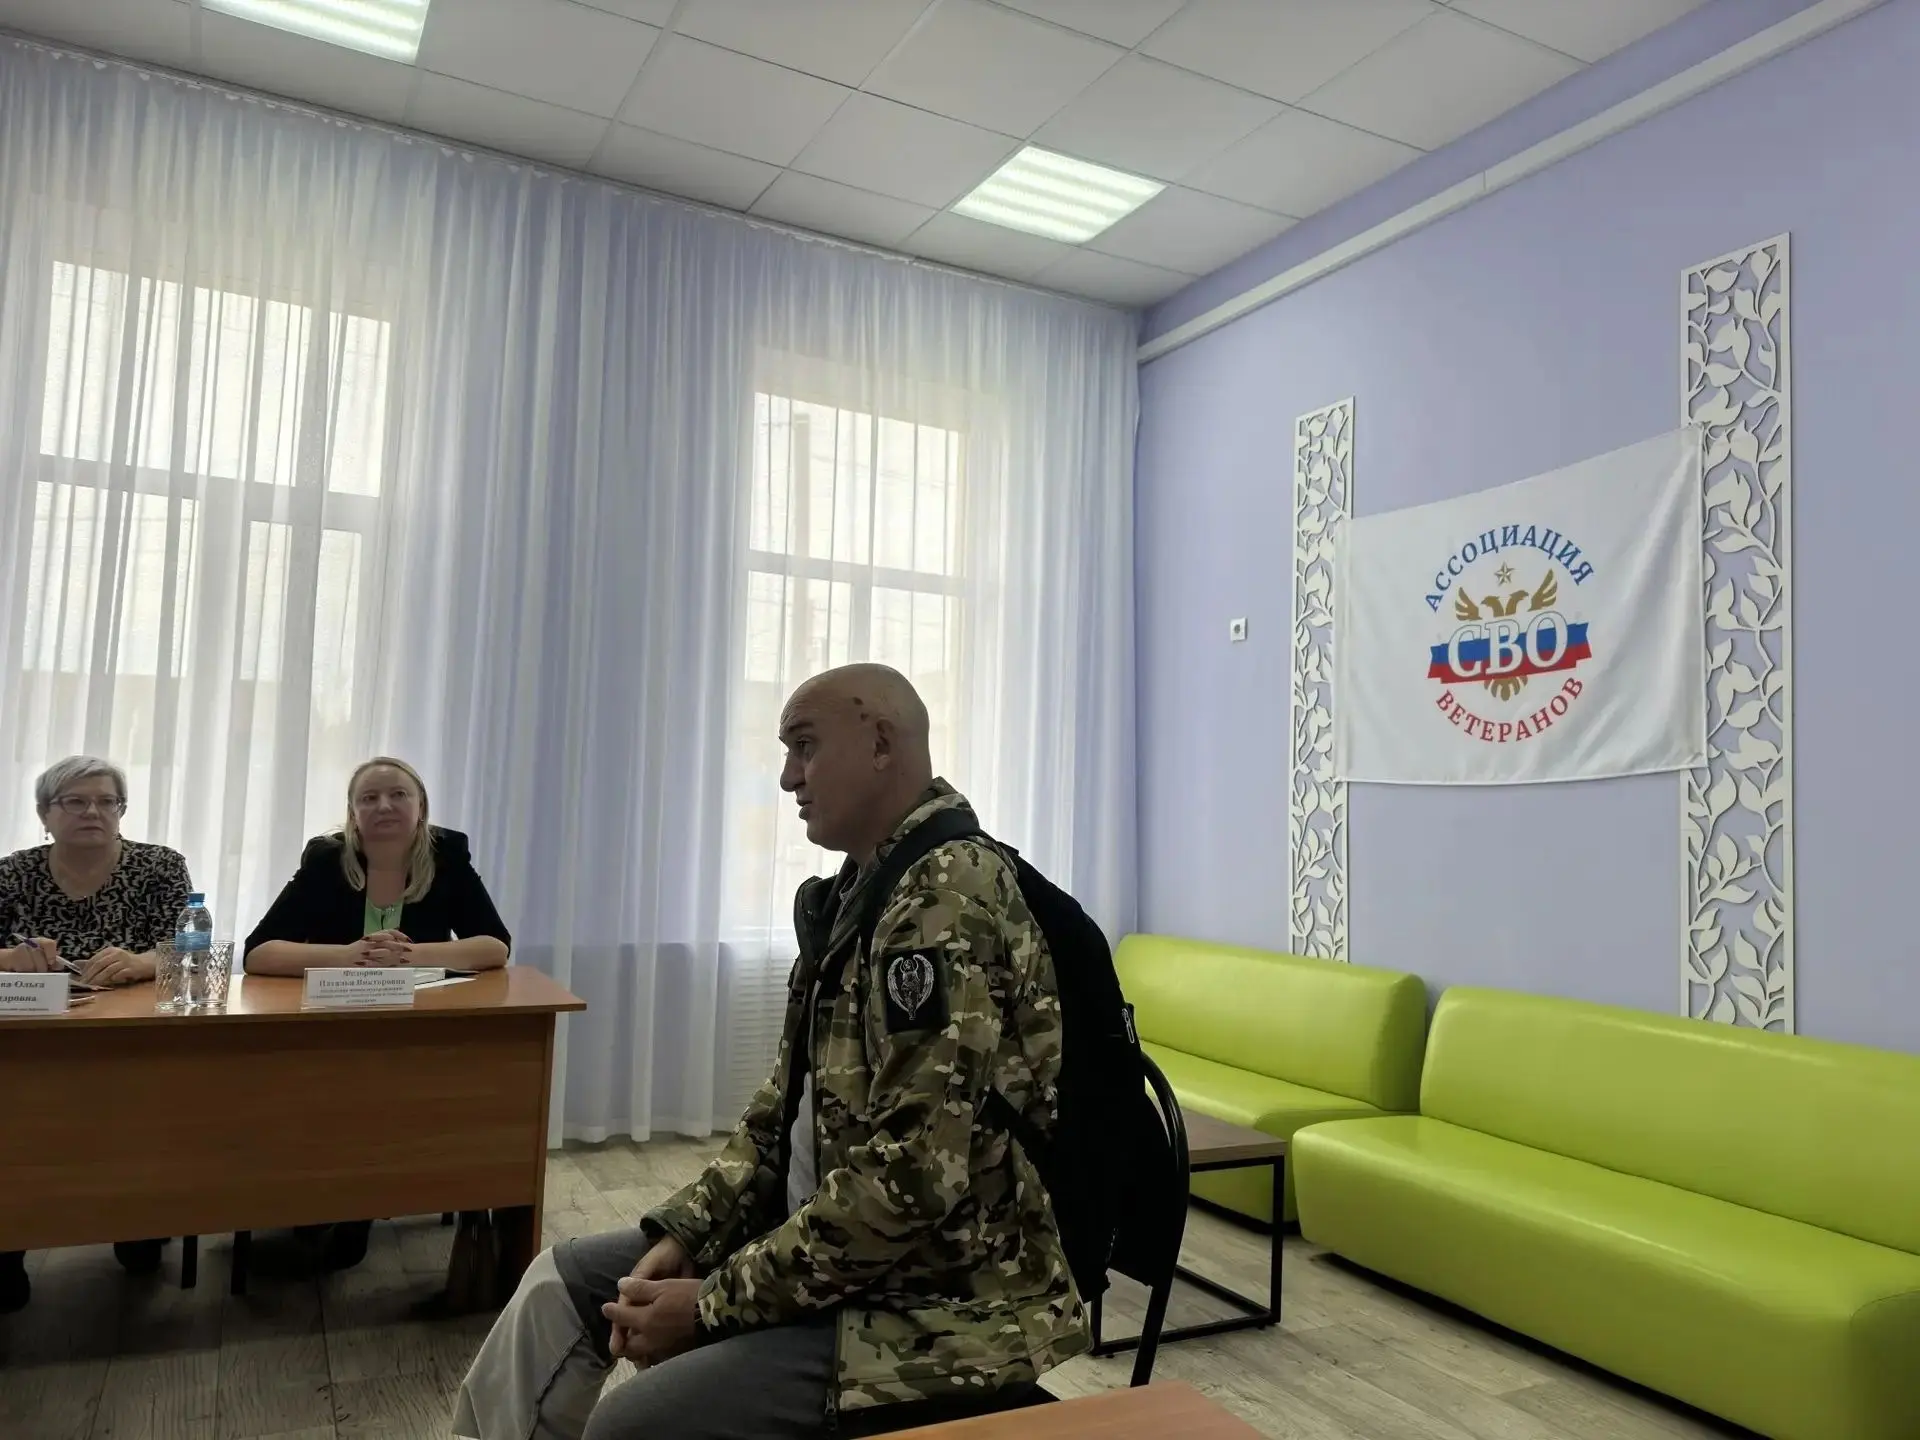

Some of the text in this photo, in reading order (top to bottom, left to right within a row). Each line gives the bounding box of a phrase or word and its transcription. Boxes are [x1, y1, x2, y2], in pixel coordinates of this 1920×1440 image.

[1425, 524, 1594, 612] АССОЦИАЦИЯ
[1447, 610, 1569, 678] СВО
[1436, 677, 1583, 743] ВЕТЕРАНОВ
